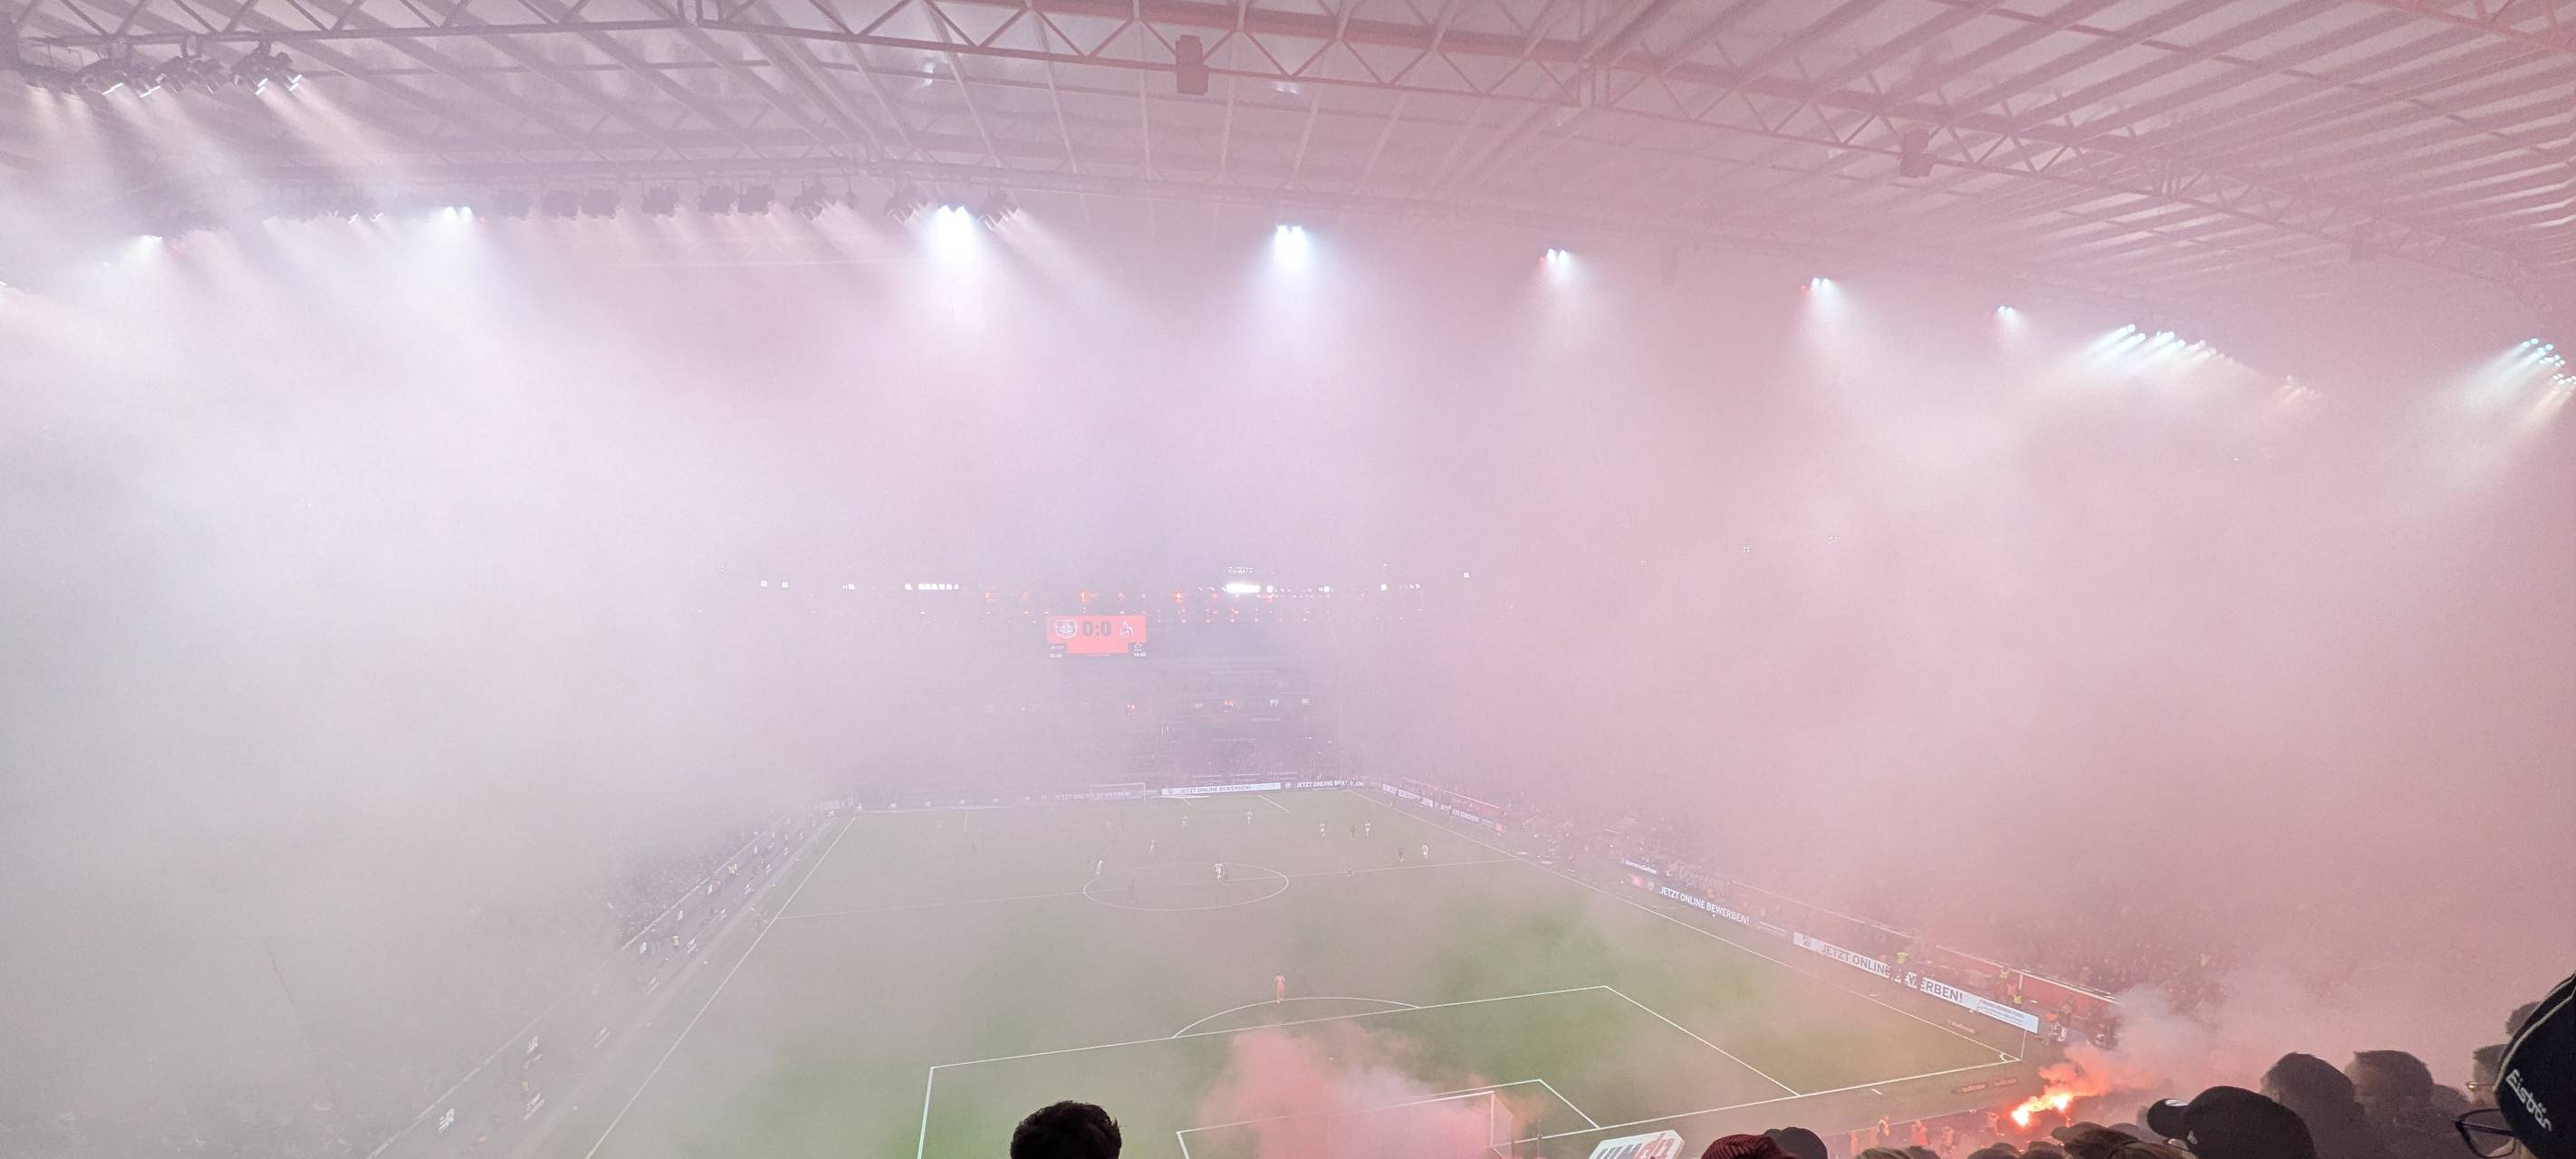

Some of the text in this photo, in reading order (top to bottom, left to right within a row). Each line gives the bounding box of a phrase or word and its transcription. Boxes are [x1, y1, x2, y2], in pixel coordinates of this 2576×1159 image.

[1082, 620, 1111, 637] 0:0
[1659, 886, 1749, 924] JETZT ONLINE BEWERBEN!
[1821, 944, 1850, 961] JETZT
[2505, 1068, 2552, 1132] Eisbär
